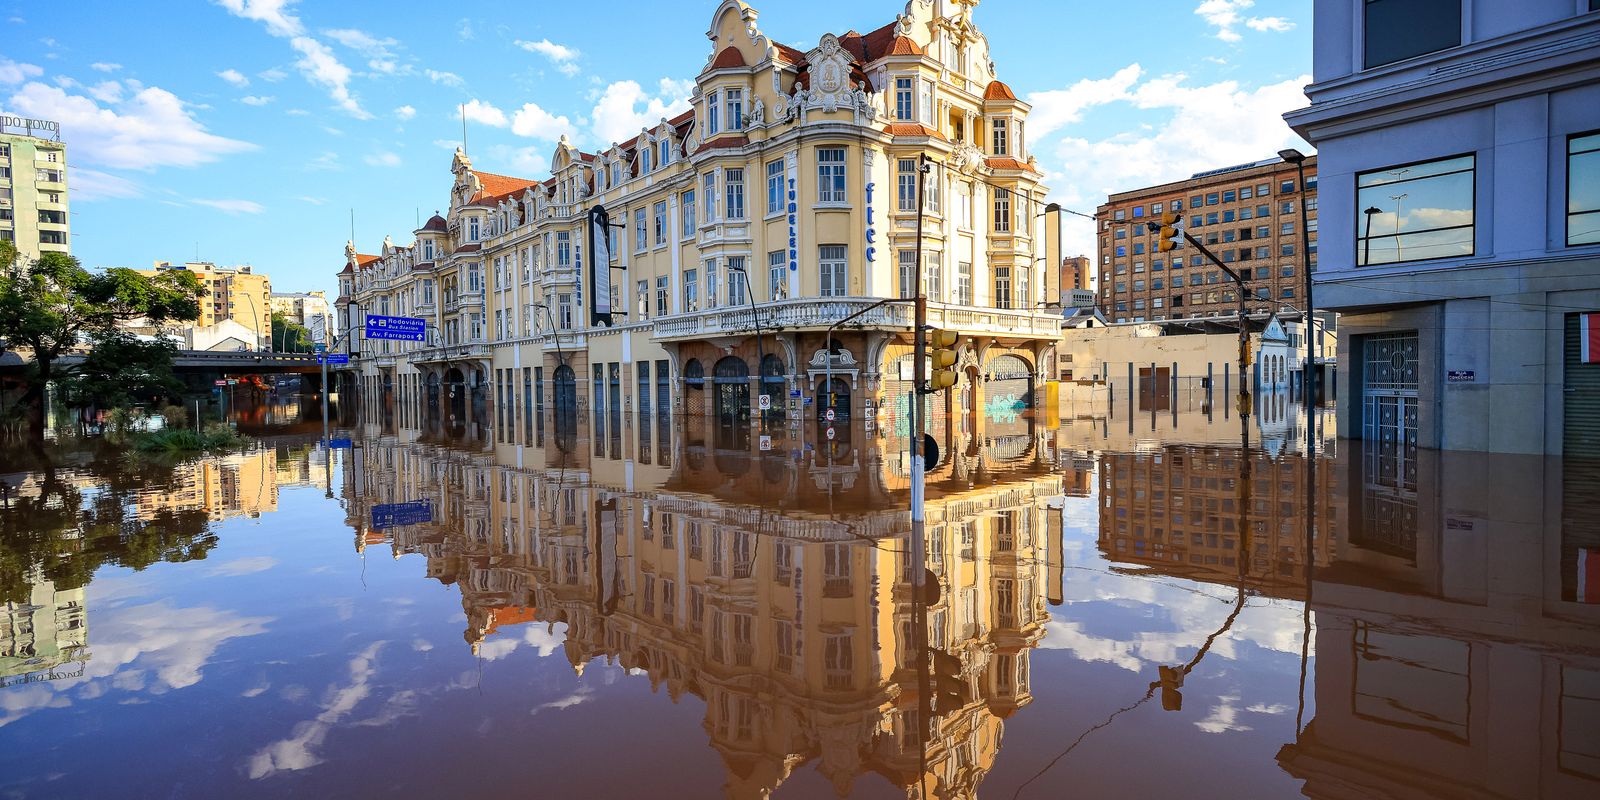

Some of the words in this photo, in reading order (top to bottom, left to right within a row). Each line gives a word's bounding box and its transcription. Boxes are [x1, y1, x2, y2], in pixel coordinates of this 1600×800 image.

[5, 116, 21, 127] DO
[25, 118, 56, 132] POVO
[787, 178, 797, 272] TUNELERO
[388, 318, 424, 326] Rodoviária
[384, 331, 415, 339] Farrapos
